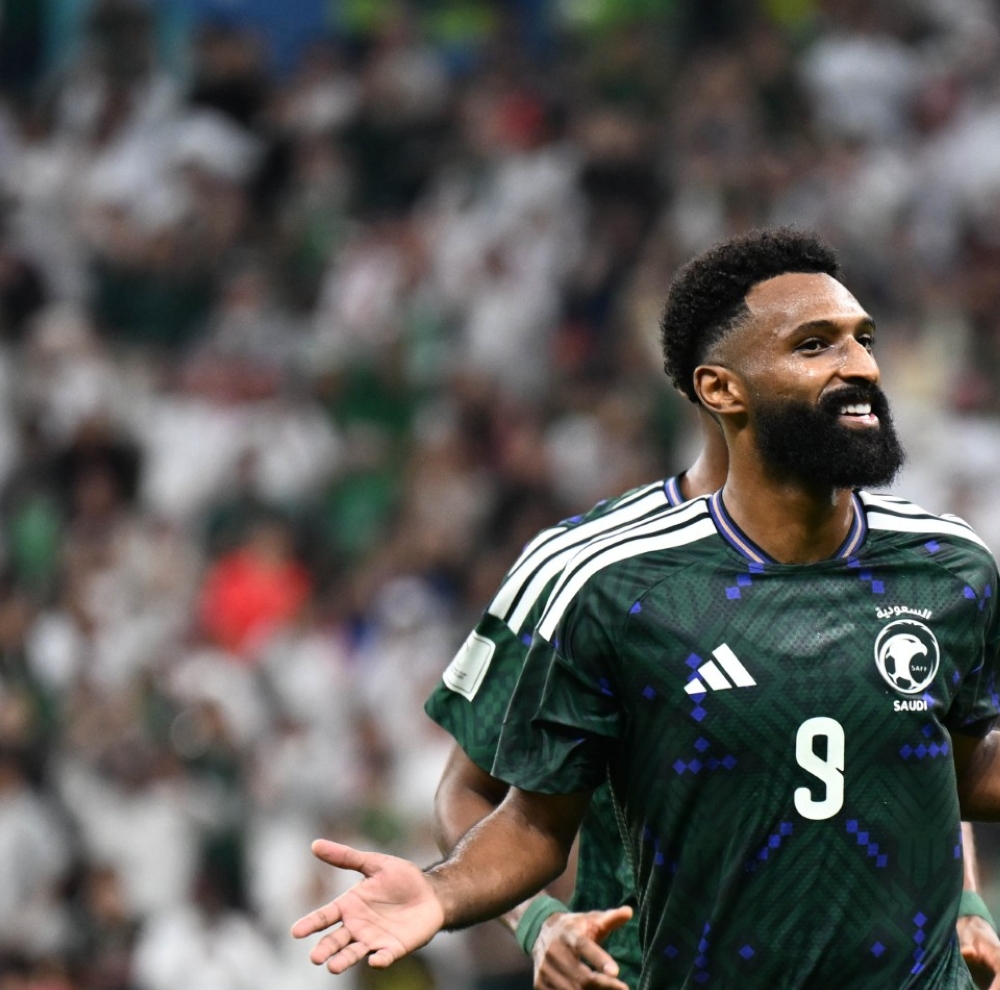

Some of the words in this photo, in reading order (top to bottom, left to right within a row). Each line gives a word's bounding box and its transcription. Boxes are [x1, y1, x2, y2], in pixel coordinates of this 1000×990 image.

[875, 605, 932, 620] السعودية
[893, 700, 928, 712] SAUDI
[794, 717, 844, 820] 9
